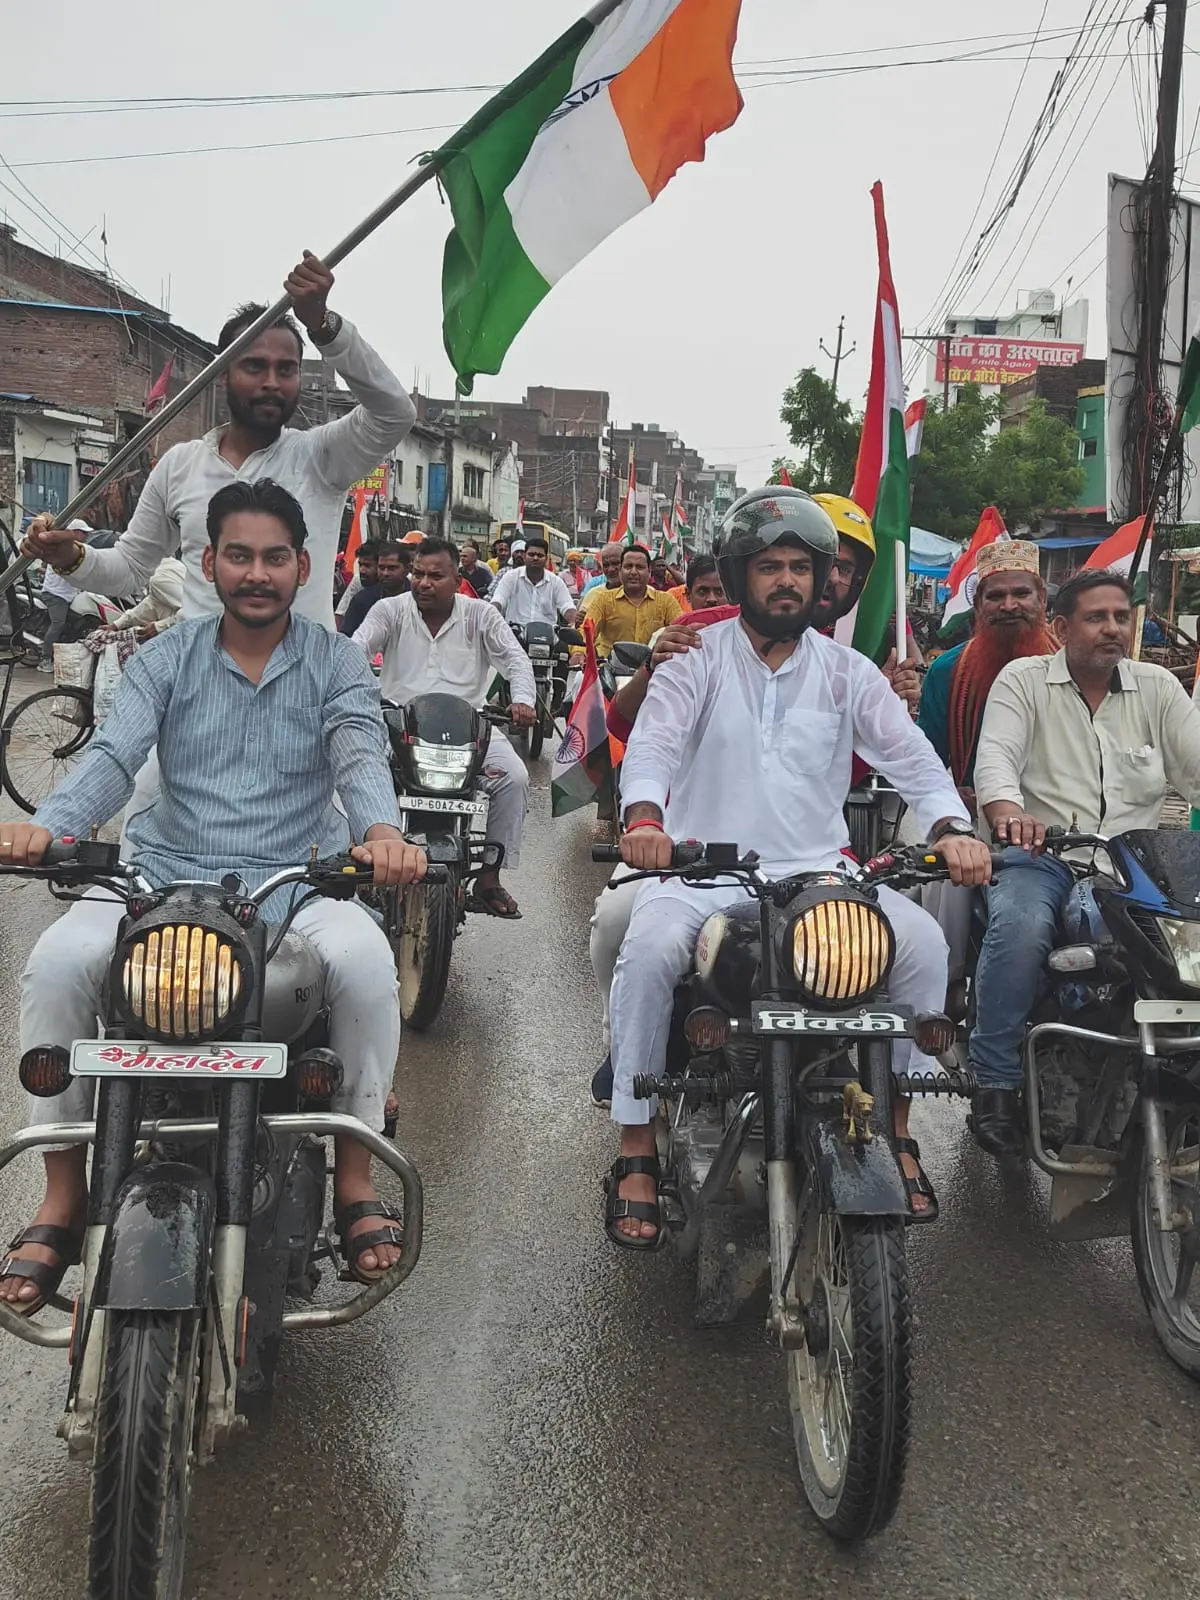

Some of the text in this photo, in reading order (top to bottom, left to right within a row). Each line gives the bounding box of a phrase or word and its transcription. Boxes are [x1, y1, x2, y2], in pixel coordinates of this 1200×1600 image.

[971, 358, 1000, 367] Smile
[1003, 360, 1032, 368] Again
[978, 343, 1003, 358] का
[1007, 344, 1080, 364] अस्पताल
[411, 798, 485, 814] UP 60AZ 6434
[758, 1010, 908, 1032] विक्की
[121, 1048, 272, 1072] महादेव
